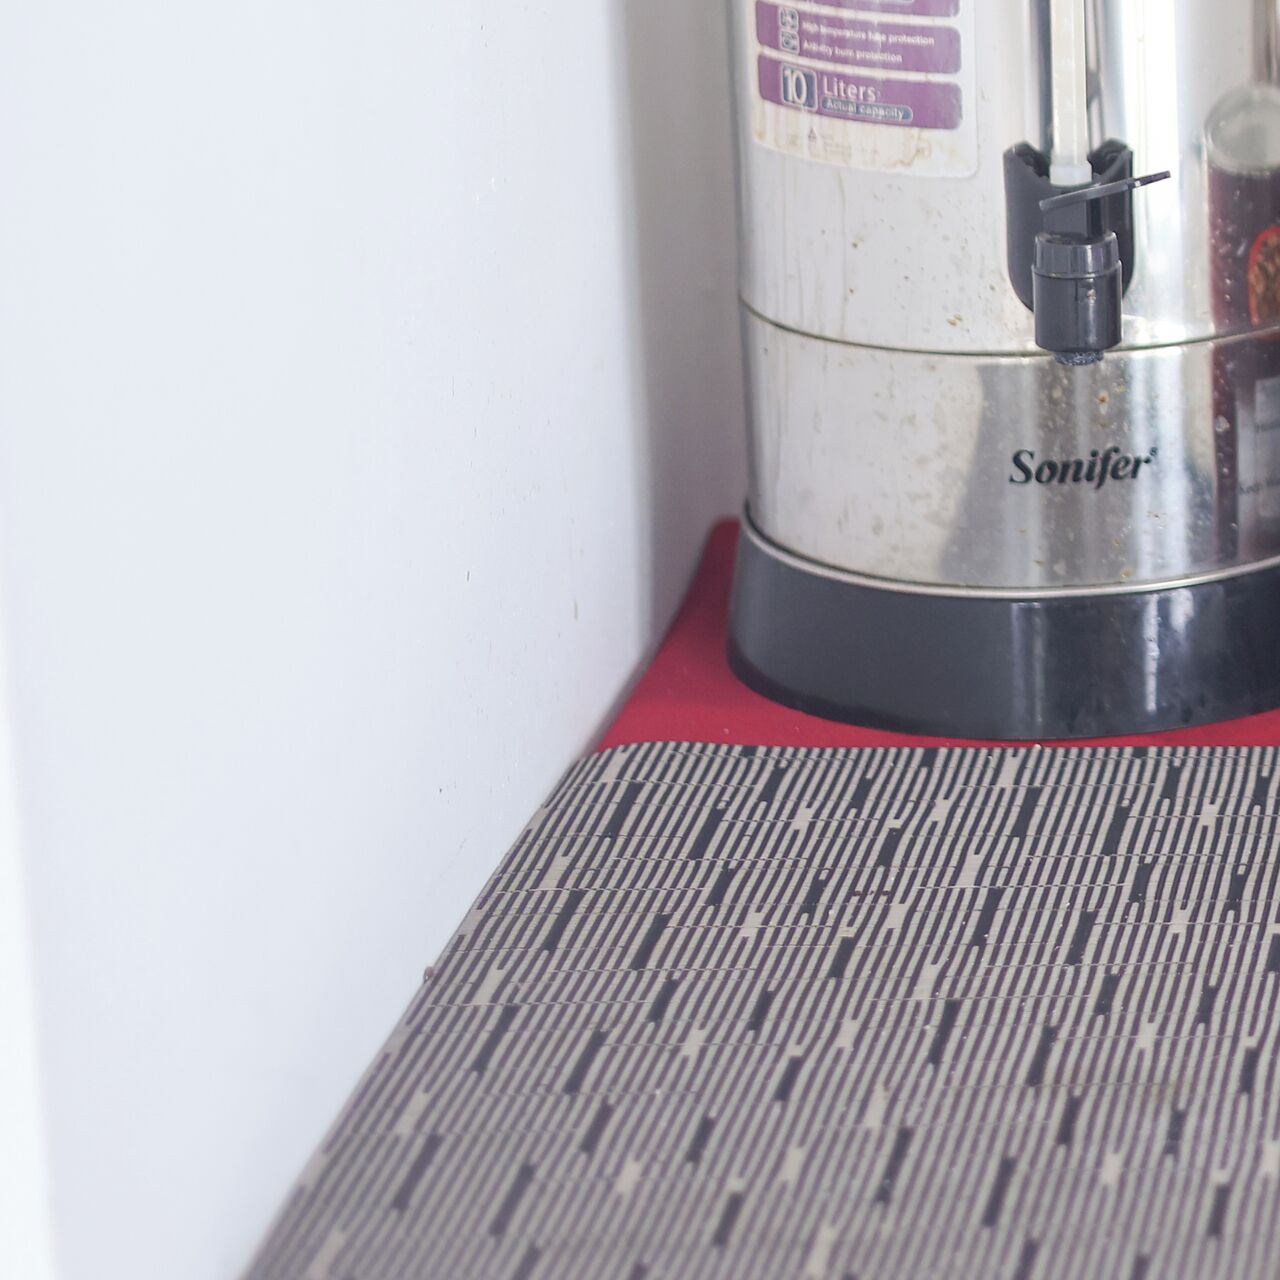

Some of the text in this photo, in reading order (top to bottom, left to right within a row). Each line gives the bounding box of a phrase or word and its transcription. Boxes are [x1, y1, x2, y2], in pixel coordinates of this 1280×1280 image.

[889, 33, 935, 47] protection
[783, 67, 876, 106] 10 Liters
[827, 98, 904, 120] Actual capacity
[1009, 445, 1153, 489] Sonifer
